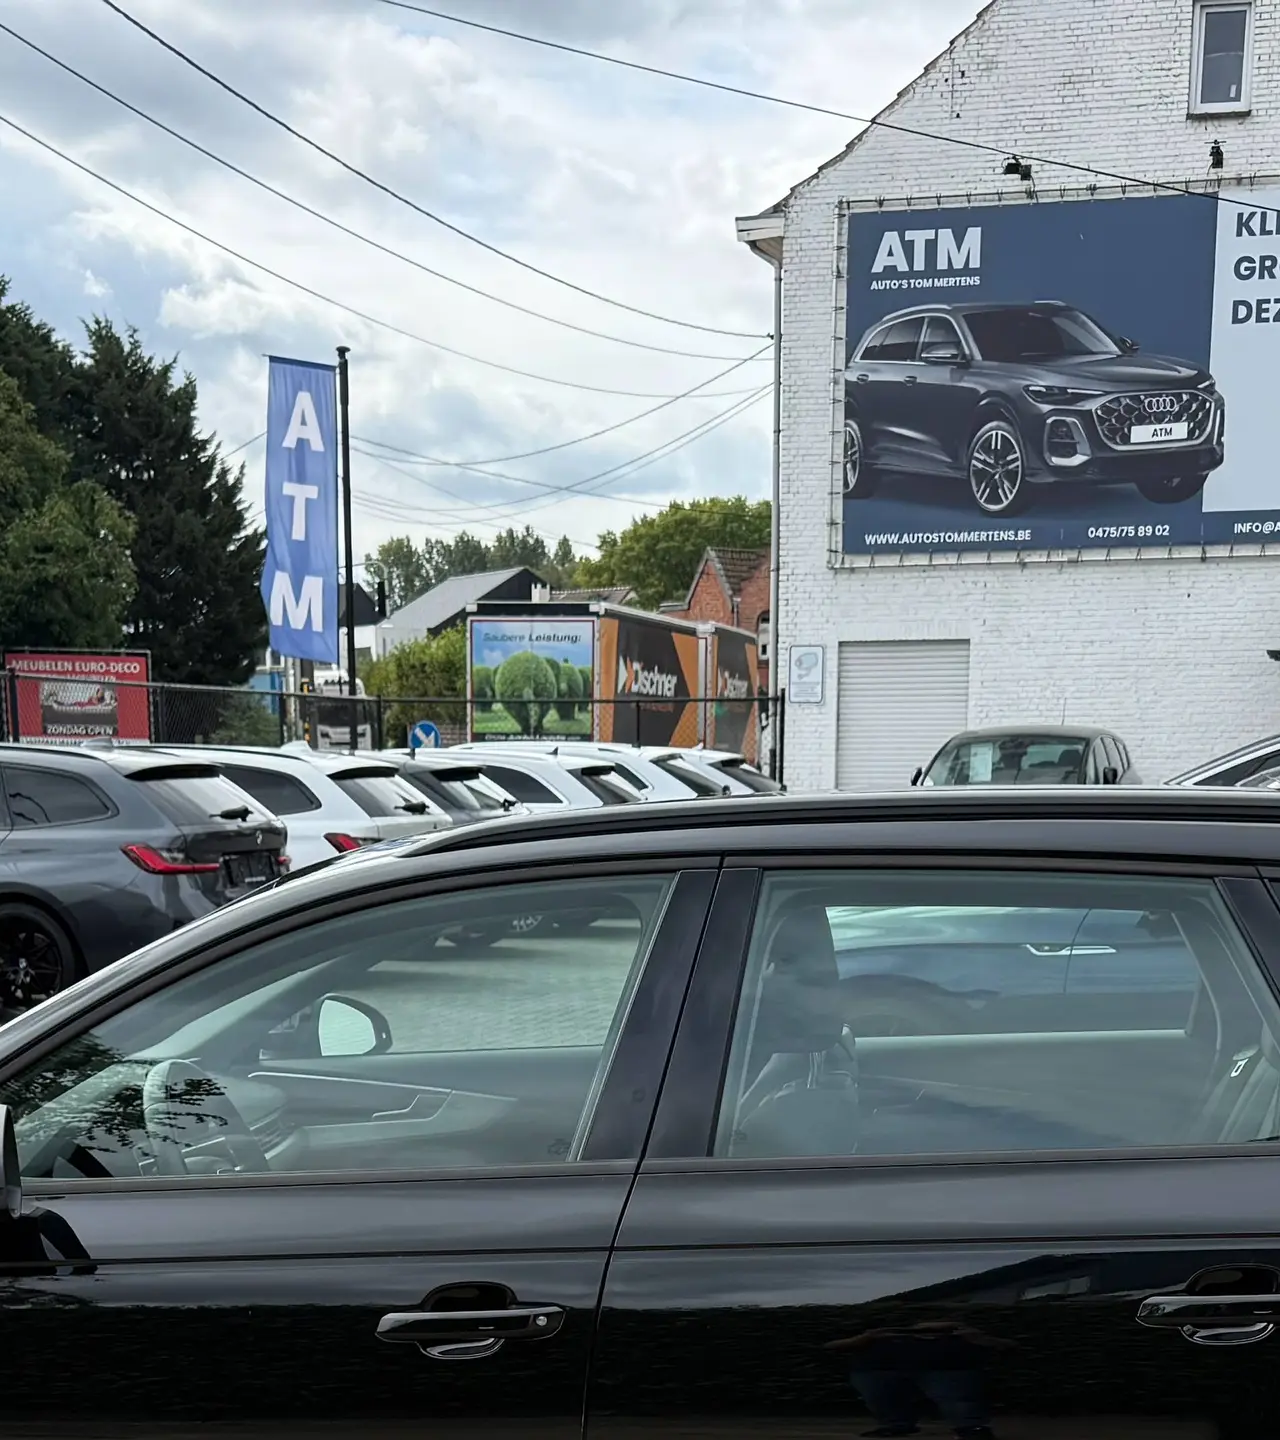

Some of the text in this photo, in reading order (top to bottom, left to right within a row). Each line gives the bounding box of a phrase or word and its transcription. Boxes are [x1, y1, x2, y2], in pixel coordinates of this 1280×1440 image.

[870, 226, 982, 273] ATM
[870, 276, 981, 290] AUTO'S TOM MERTENS
[1151, 427, 1173, 438] ATM
[270, 390, 325, 632] ATM
[864, 529, 1032, 545] WWW.AUTOSTOMMERTENS.BE
[1087, 524, 1170, 539] 0475/75 89 02
[11, 659, 140, 674] MEUBELEN EURO-DECO
